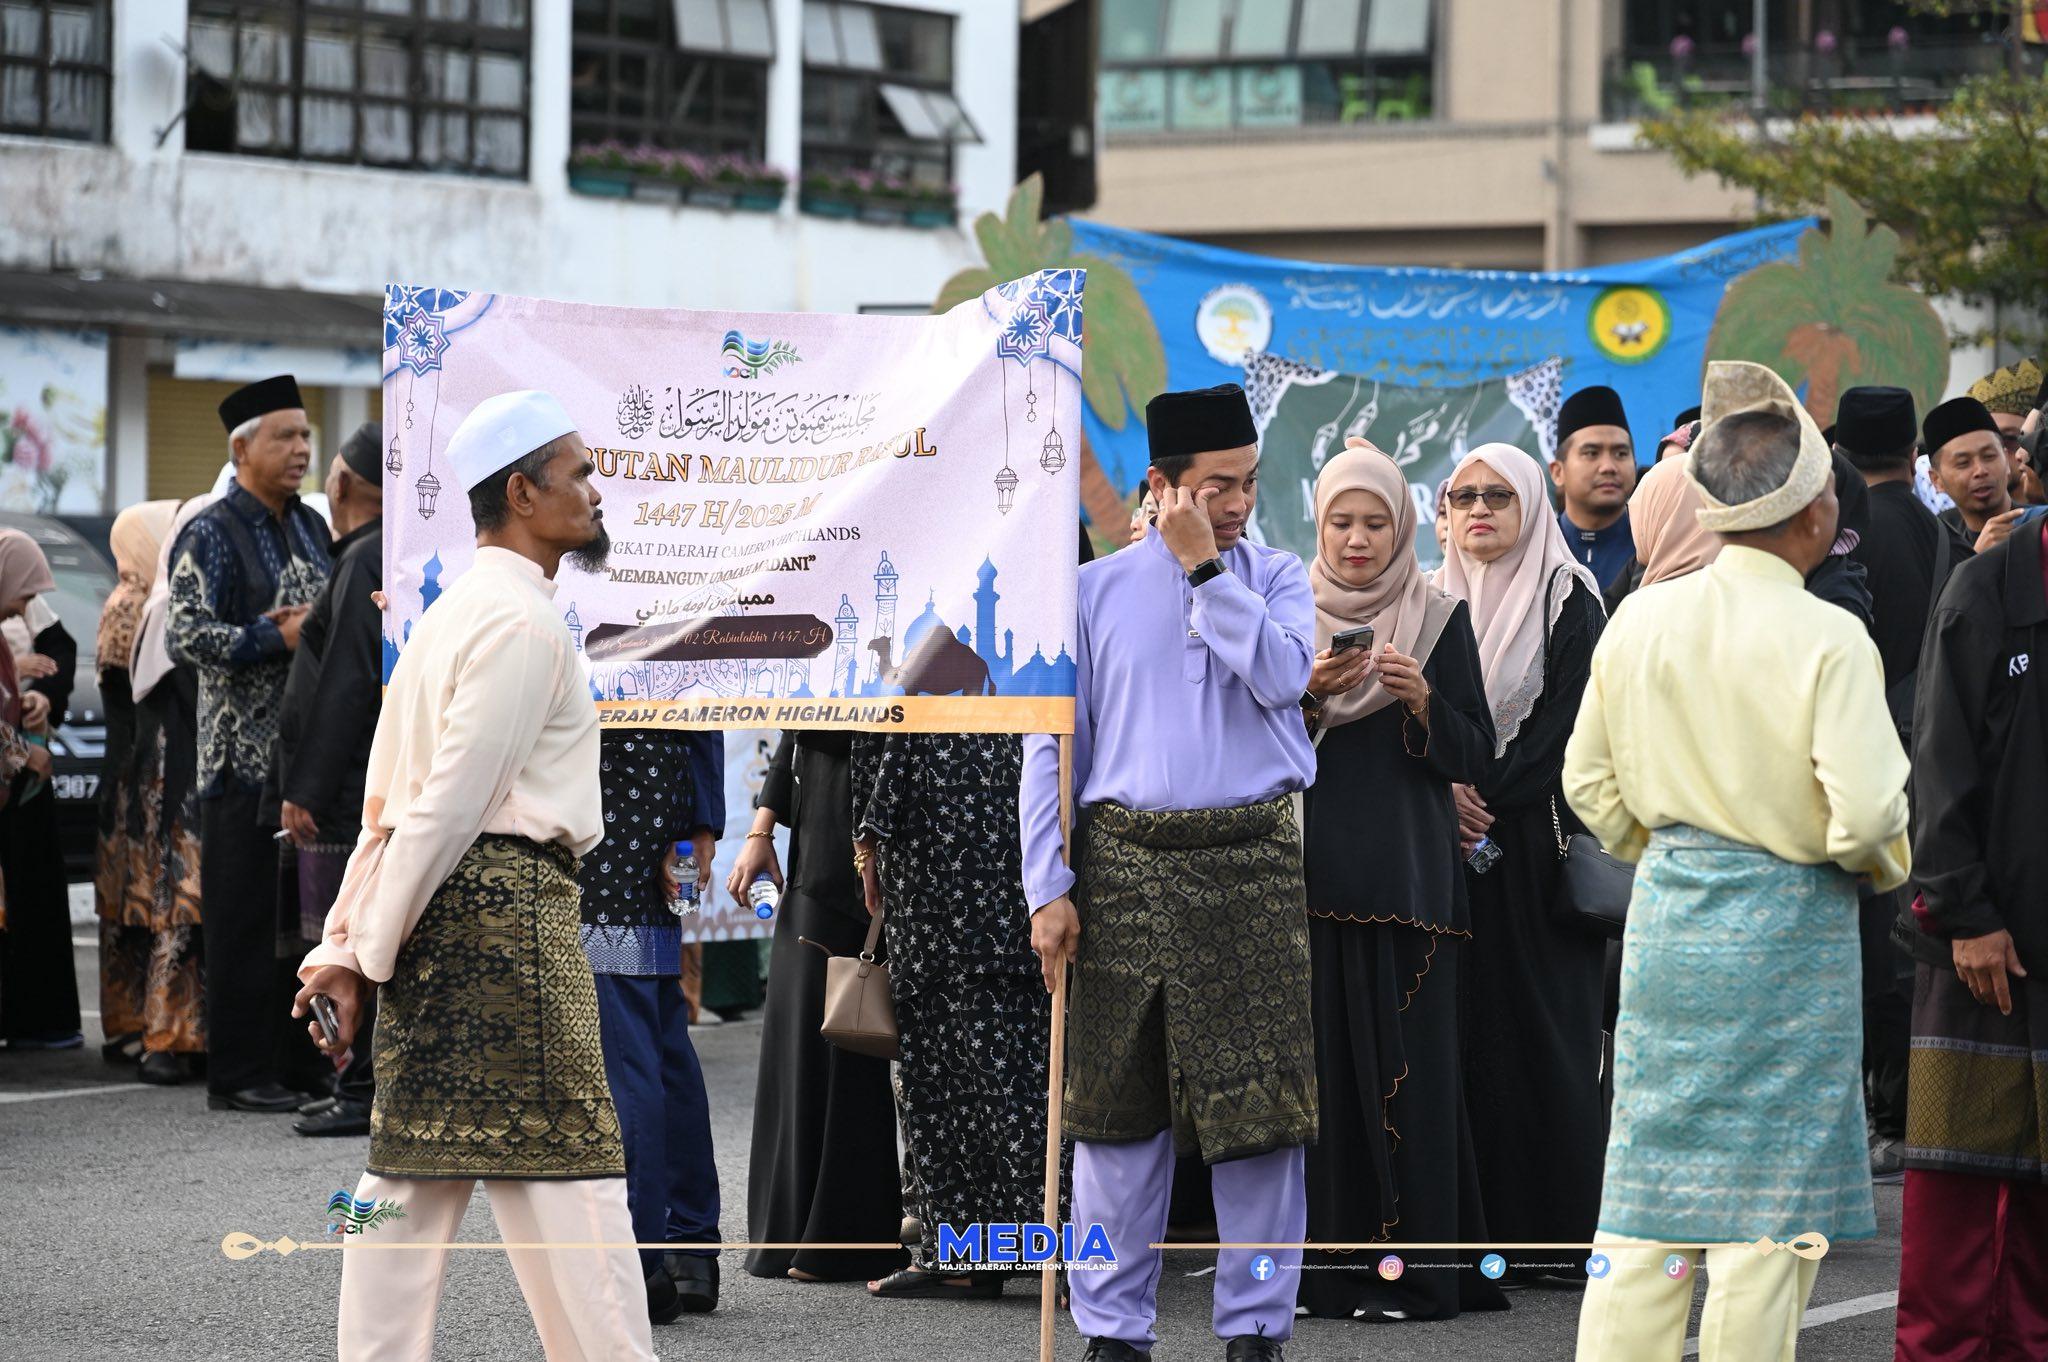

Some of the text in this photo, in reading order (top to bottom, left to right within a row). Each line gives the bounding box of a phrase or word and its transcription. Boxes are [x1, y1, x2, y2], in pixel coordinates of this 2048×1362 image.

[698, 451, 853, 484] MAULIDUR
[634, 502, 697, 527] 1447
[700, 499, 792, 535] H/2025
[657, 543, 718, 559] DAERAH
[662, 706, 770, 723] CAMERON
[775, 705, 905, 724] HIGHLANDS
